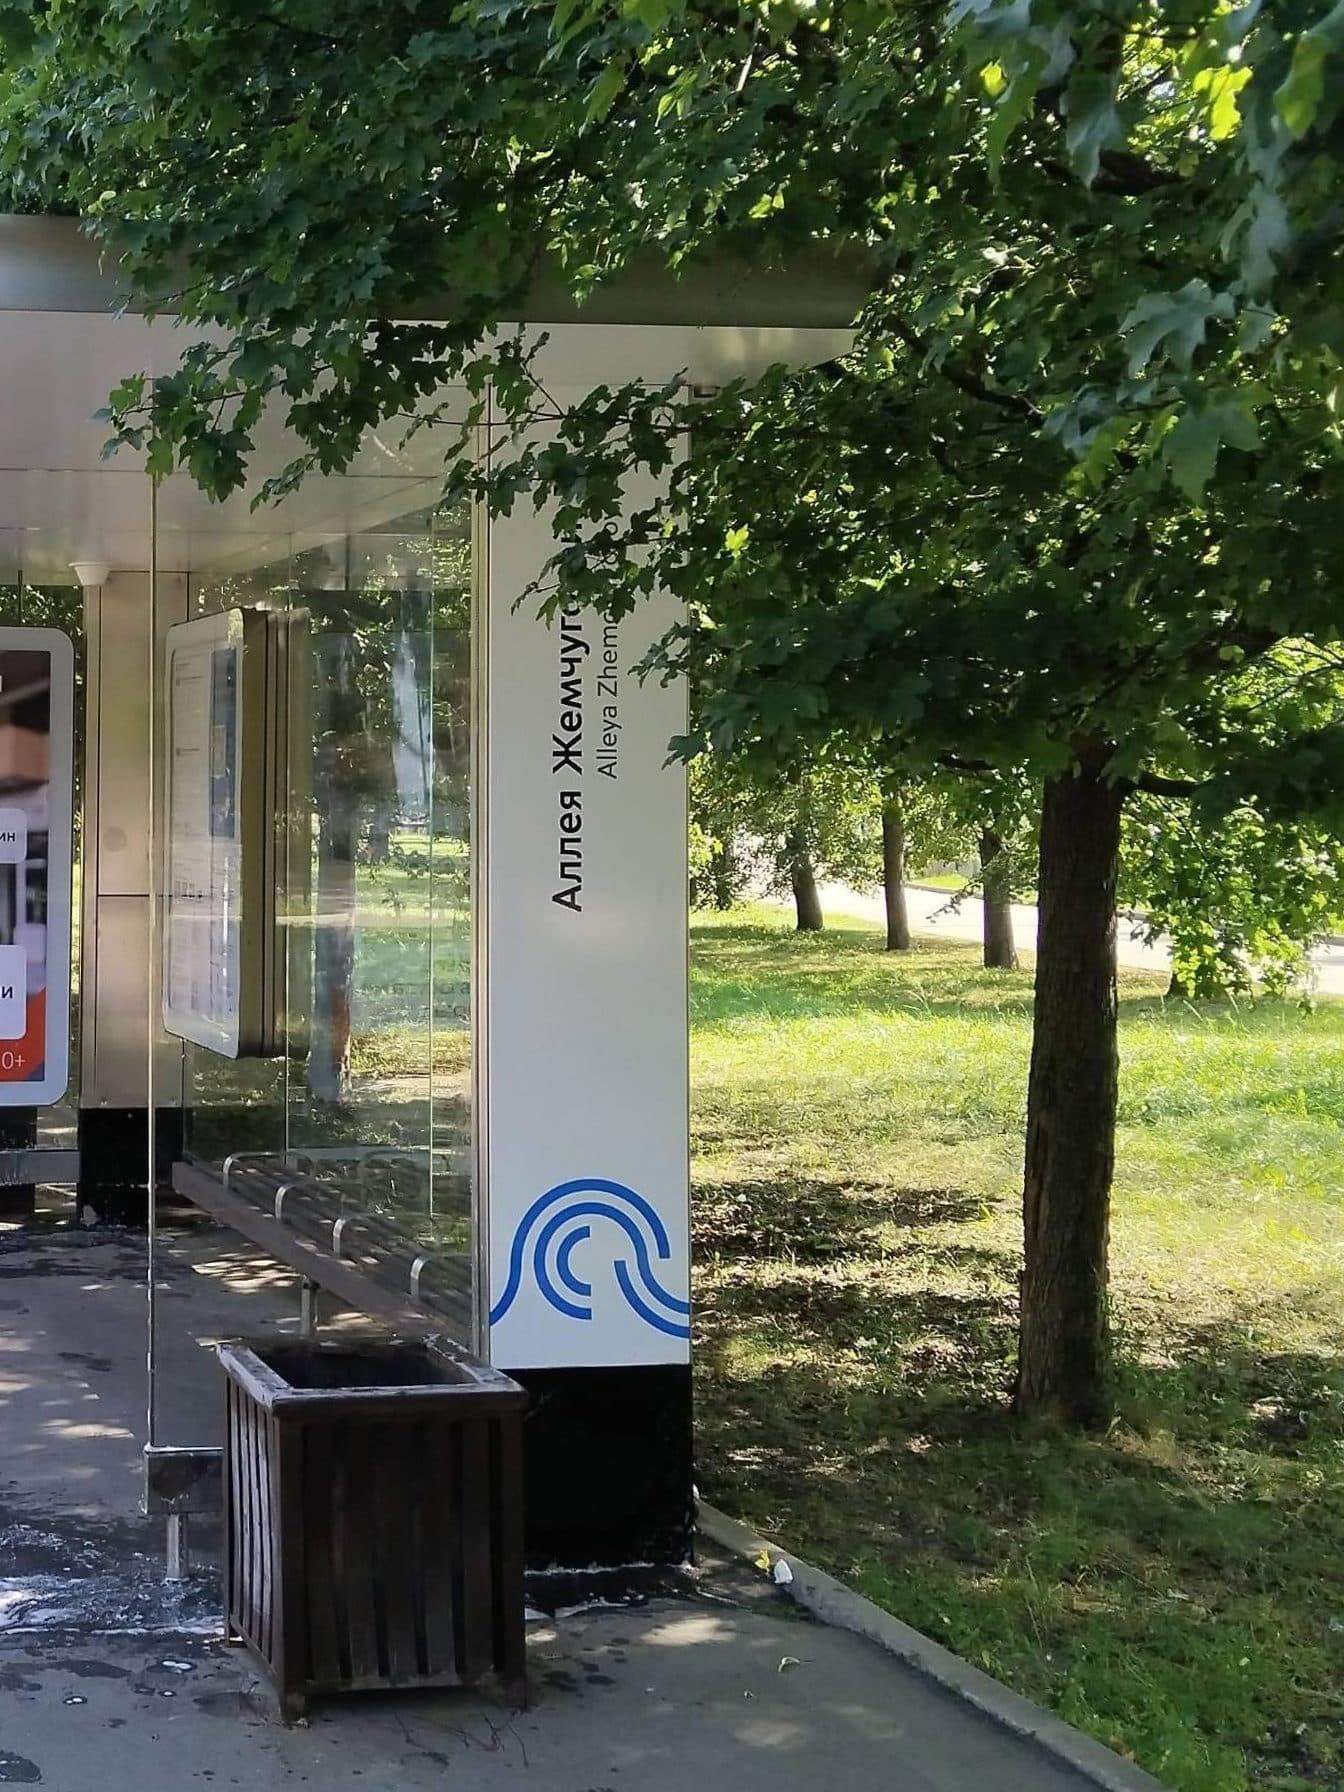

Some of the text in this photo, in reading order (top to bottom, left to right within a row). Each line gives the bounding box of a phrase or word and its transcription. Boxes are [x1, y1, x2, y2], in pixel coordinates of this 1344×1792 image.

[596, 706, 622, 779] Alleya
[552, 791, 582, 912] Аллея
[1, 1051, 26, 1069] 0+
